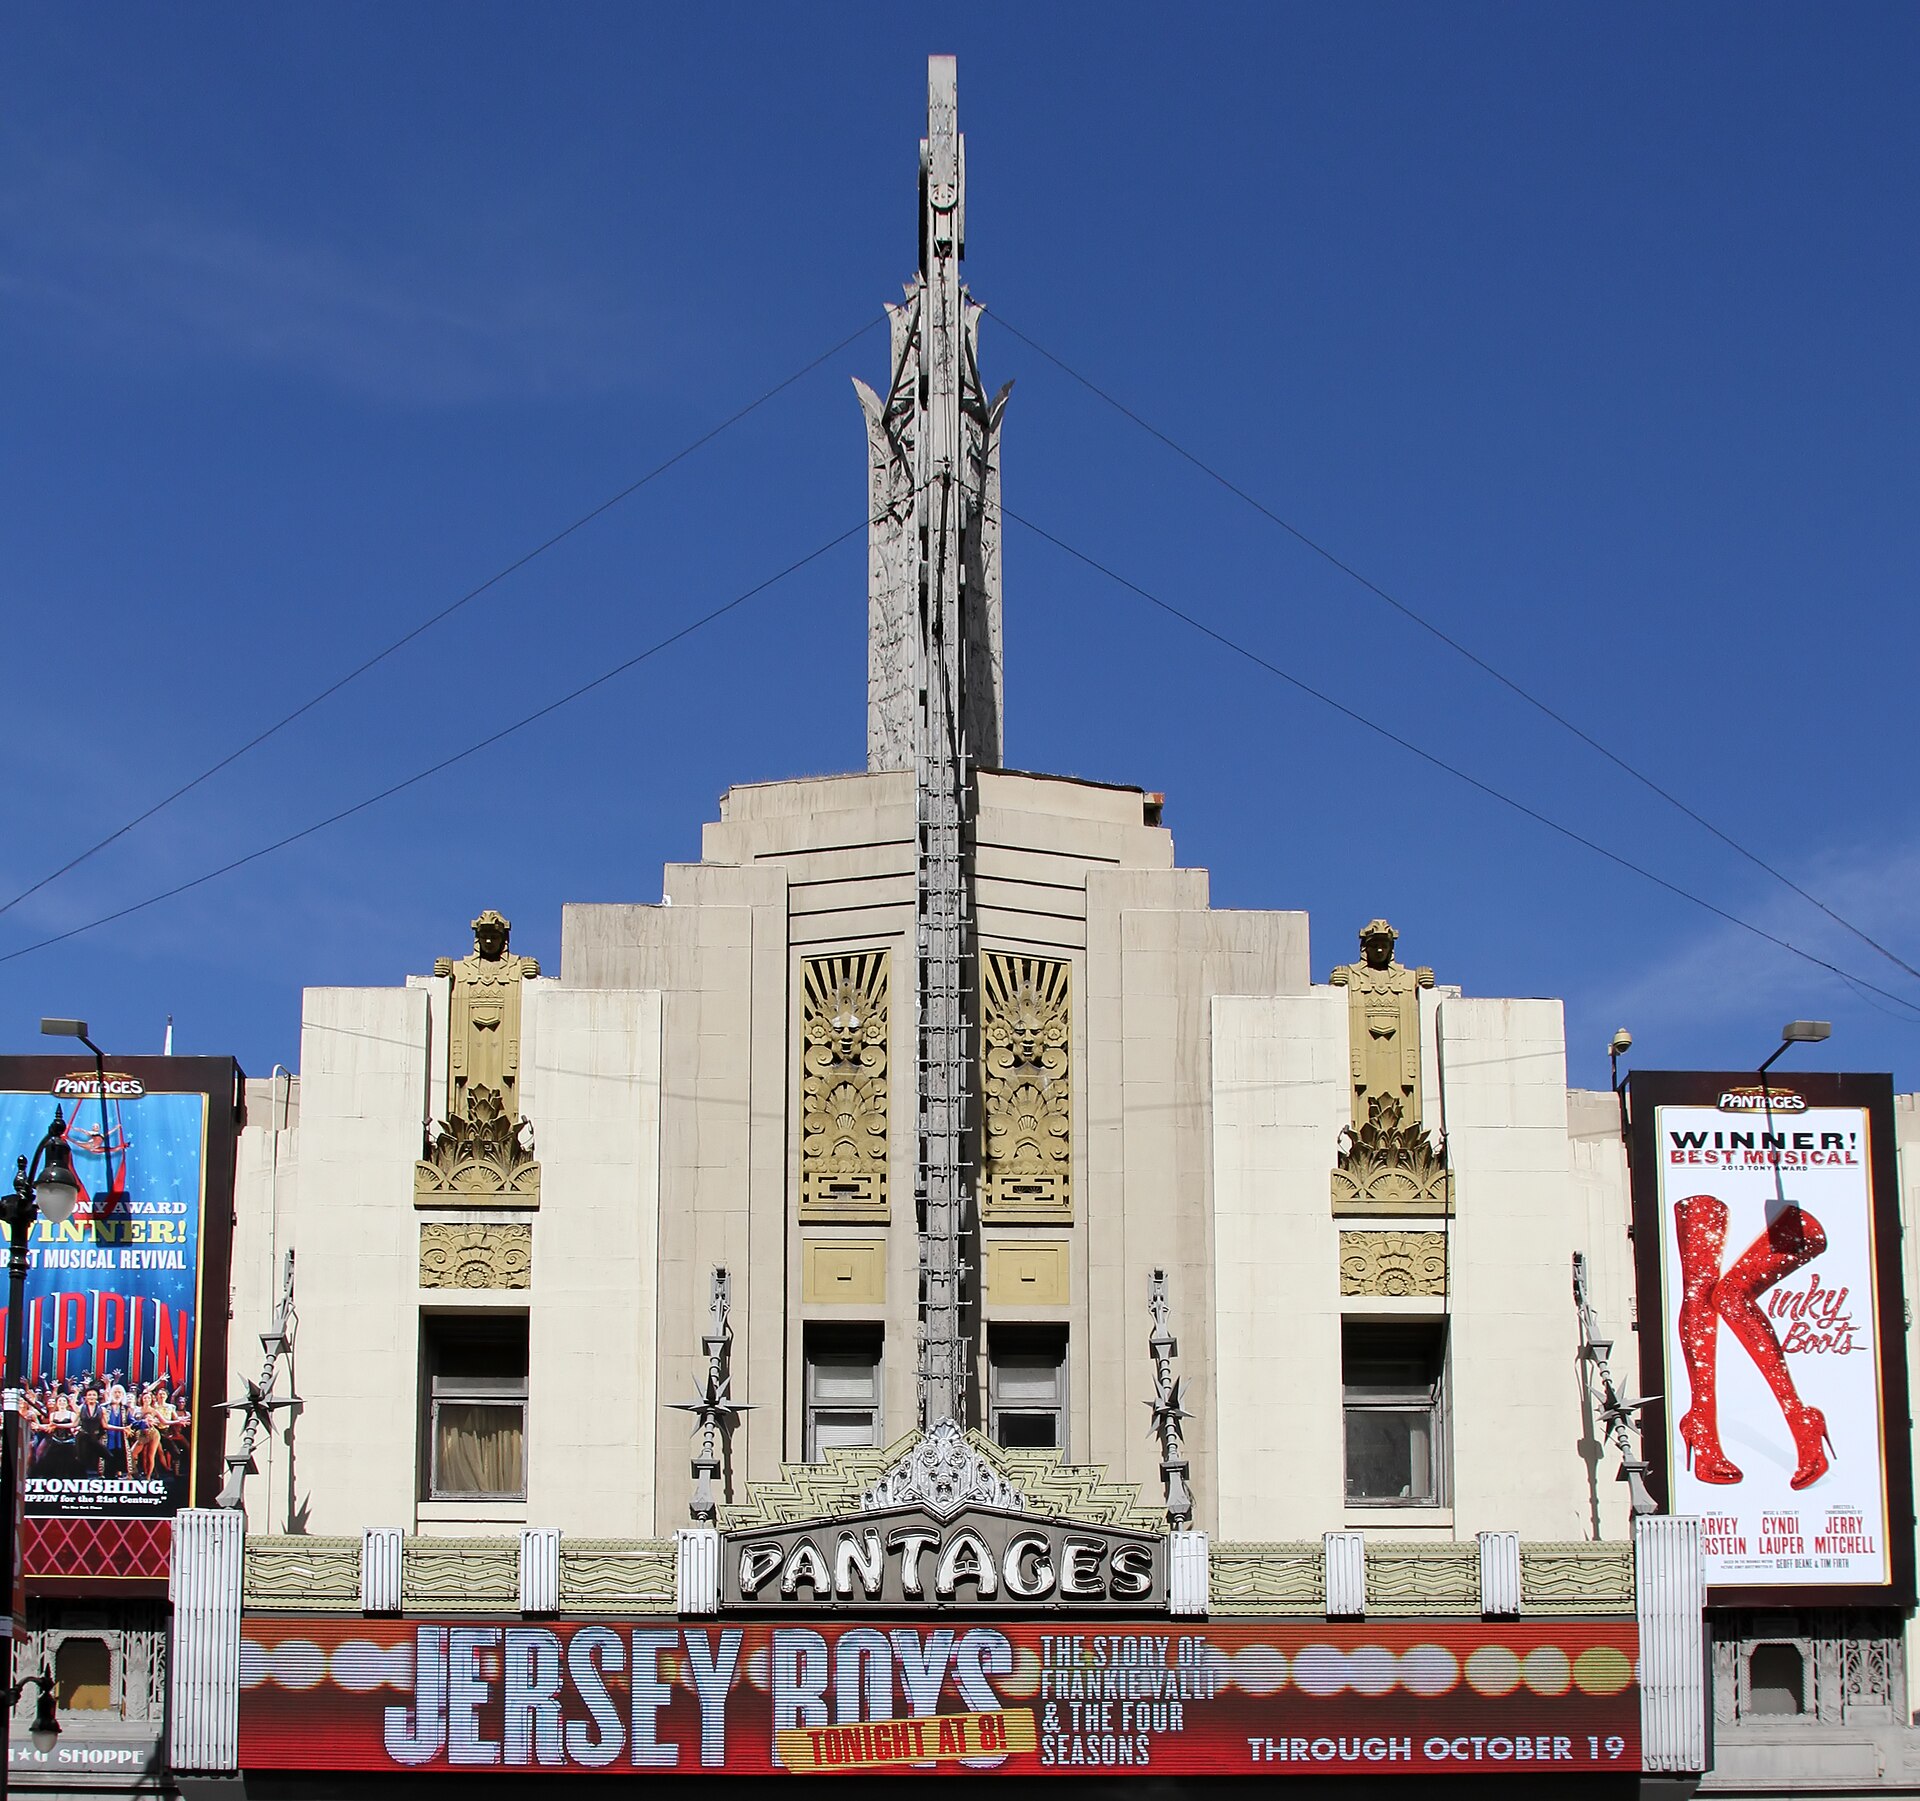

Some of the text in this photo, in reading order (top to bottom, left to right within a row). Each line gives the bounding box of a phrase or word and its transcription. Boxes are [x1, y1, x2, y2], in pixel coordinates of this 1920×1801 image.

[54, 1079, 143, 1094] PANTAGES
[1719, 1094, 1806, 1109] PANTAGES
[1670, 1131, 1857, 1149] WINNER!
[1670, 1150, 1859, 1165] BEST MUSICAL
[111, 1202, 187, 1214] AWARD
[44, 1249, 116, 1269] MUSICAL
[120, 1250, 187, 1269] REVIVAL
[0, 1289, 188, 1393] IPPIN
[1780, 1320, 1868, 1354] Boots
[25, 1479, 168, 1495] STONISHING.
[60, 1495, 76, 1503] for
[78, 1495, 94, 1503] the
[96, 1495, 117, 1503] 21st
[1700, 1518, 1738, 1535] ARVEY
[1762, 1517, 1799, 1534] CYNDI
[1825, 1516, 1863, 1534] JERRY
[1759, 1537, 1804, 1554] LAUPER
[1815, 1536, 1876, 1554] MITCHELL
[738, 1524, 1154, 1598] PANTAGES
[1040, 1636, 1206, 1667] THE STORY OF
[1041, 1669, 1214, 1699] FRANKIE VALLI
[384, 1626, 1013, 1767] JERSEY BOYS
[1041, 1701, 1184, 1733] & THE FOUR
[807, 1713, 1008, 1765] TONIGHT AT 8!
[58, 1748, 145, 1765] SHOPPE
[1041, 1734, 1150, 1766] SEASONS
[1247, 1736, 1625, 1761] THROUGH OCTOBER 19
